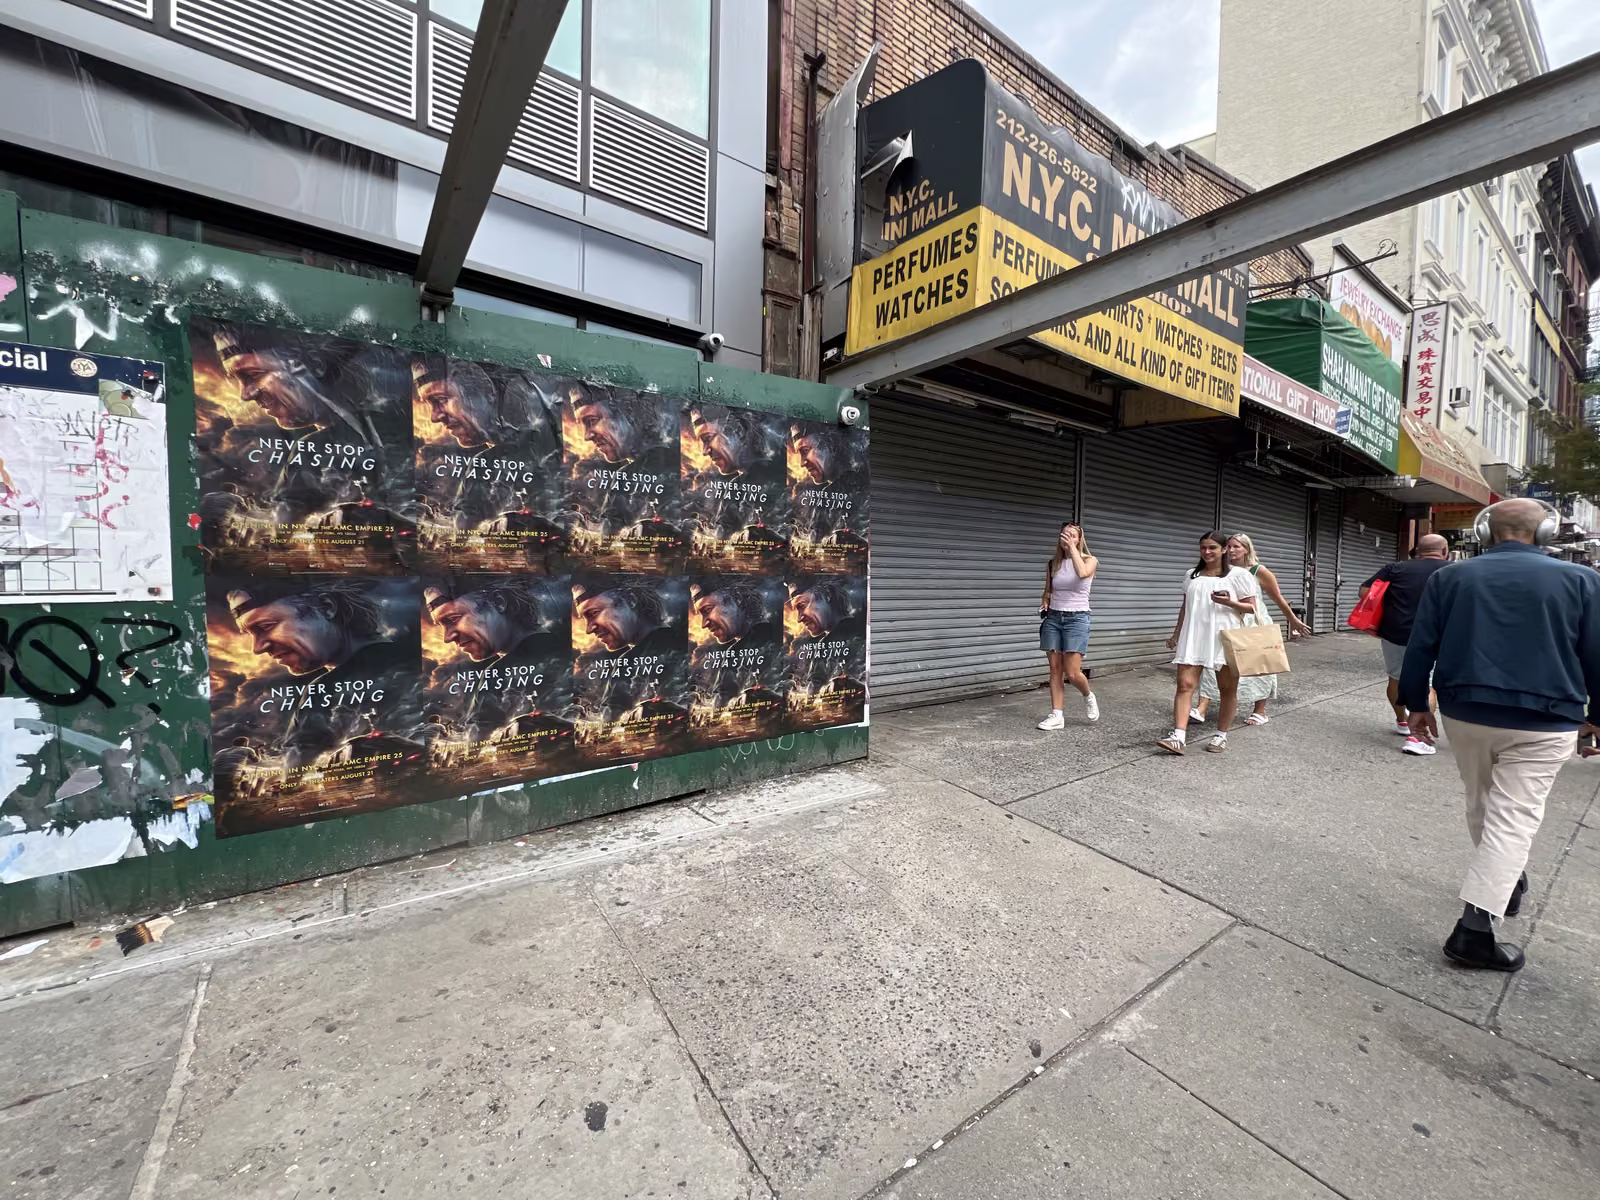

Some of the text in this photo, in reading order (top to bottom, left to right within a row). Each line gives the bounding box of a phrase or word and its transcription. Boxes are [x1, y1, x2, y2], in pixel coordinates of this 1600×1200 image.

[996, 110, 1098, 194] 212-226-5822
[889, 179, 934, 216] N.Y.C.
[1002, 140, 1101, 250] N.Y.C.
[880, 191, 958, 241] INI MALL
[872, 222, 978, 295] PERFUMES
[875, 268, 969, 329] WATCHES
[992, 229, 1067, 282] PERFUM
[1101, 303, 1144, 333] HIRTS
[1155, 316, 1203, 360] WATCHES
[1211, 344, 1237, 375] BELTS
[1147, 291, 1192, 316] HOP
[1340, 275, 1402, 341] JEWELRY EXCHANGE
[1084, 322, 1112, 355] AND
[1114, 336, 1137, 367] ALL
[1140, 347, 1167, 378] KIND
[1169, 359, 1183, 382] OF
[1185, 366, 1207, 393] GIFT
[1208, 374, 1235, 404] ITEMS
[1286, 387, 1309, 415] GIFT
[1312, 399, 1336, 425] SHOP
[1372, 381, 1386, 415] GIFT
[1385, 389, 1400, 425] SHOP
[259, 437, 365, 456] NEVER STOP
[248, 449, 376, 471] CHASING
[443, 454, 525, 471] NEVER STOP
[435, 465, 534, 483] CHASING
[593, 469, 658, 483] NEVER STOP
[587, 478, 665, 495] CHASING
[710, 480, 762, 493] NEVER STOP
[805, 489, 848, 500] NEVER STOP
[704, 489, 768, 503] CHASING
[801, 498, 853, 510] CHASING
[708, 648, 759, 660] NEVER STOP
[798, 647, 850, 661] CHASING
[803, 640, 846, 651] NEVER STOP
[595, 656, 658, 669] NEVER STOP
[703, 655, 765, 670] CHASING
[457, 665, 536, 682] NEVER STOP
[588, 664, 665, 680] CHASING
[271, 679, 374, 698] NEVER STOP
[448, 674, 544, 695] CHASING
[259, 689, 385, 714] CHASING
[343, 758, 362, 766] AMC
[364, 754, 391, 763] EMPIRE
[393, 751, 404, 759] 25
[340, 771, 366, 780] AUGUST
